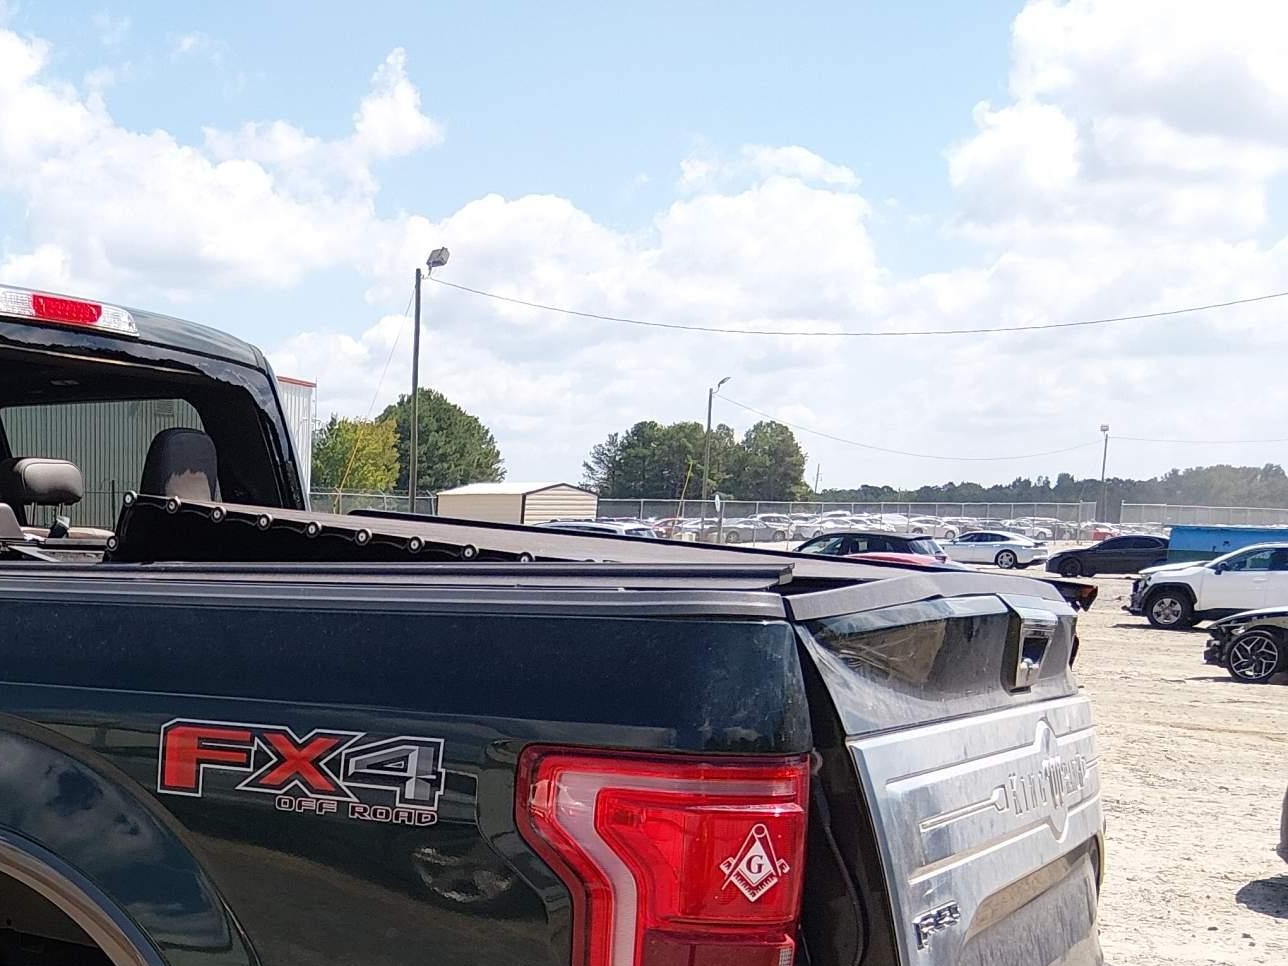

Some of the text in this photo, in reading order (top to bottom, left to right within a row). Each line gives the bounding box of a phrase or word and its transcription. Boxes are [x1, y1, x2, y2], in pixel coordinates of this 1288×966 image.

[157, 717, 445, 811] FX4
[275, 795, 439, 826] OFF ROAD
[745, 854, 765, 875] G
